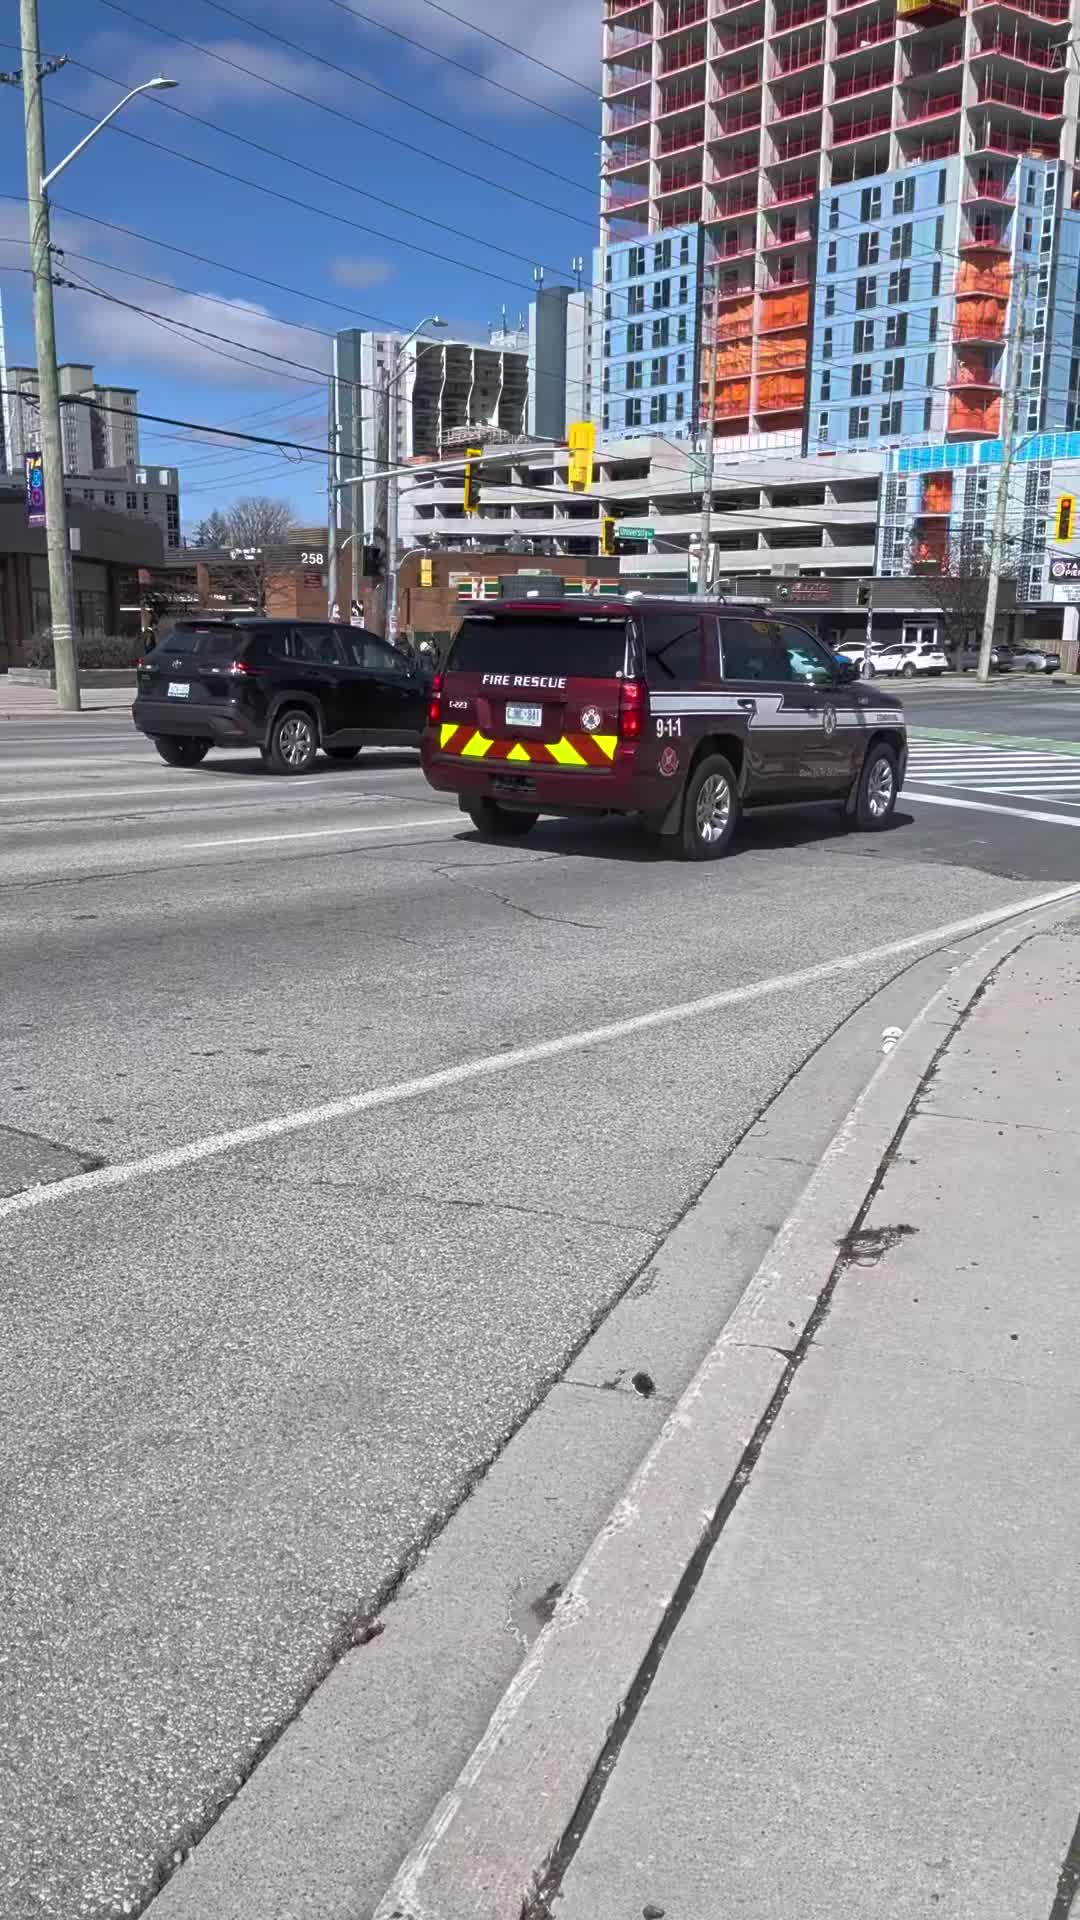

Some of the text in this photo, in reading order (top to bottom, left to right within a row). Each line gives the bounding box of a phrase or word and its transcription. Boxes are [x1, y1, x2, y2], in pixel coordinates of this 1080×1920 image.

[619, 528, 648, 539] University
[301, 552, 324, 565] 258
[482, 674, 568, 689] FIRE RESCUE
[656, 717, 682, 738] 9-1-1
